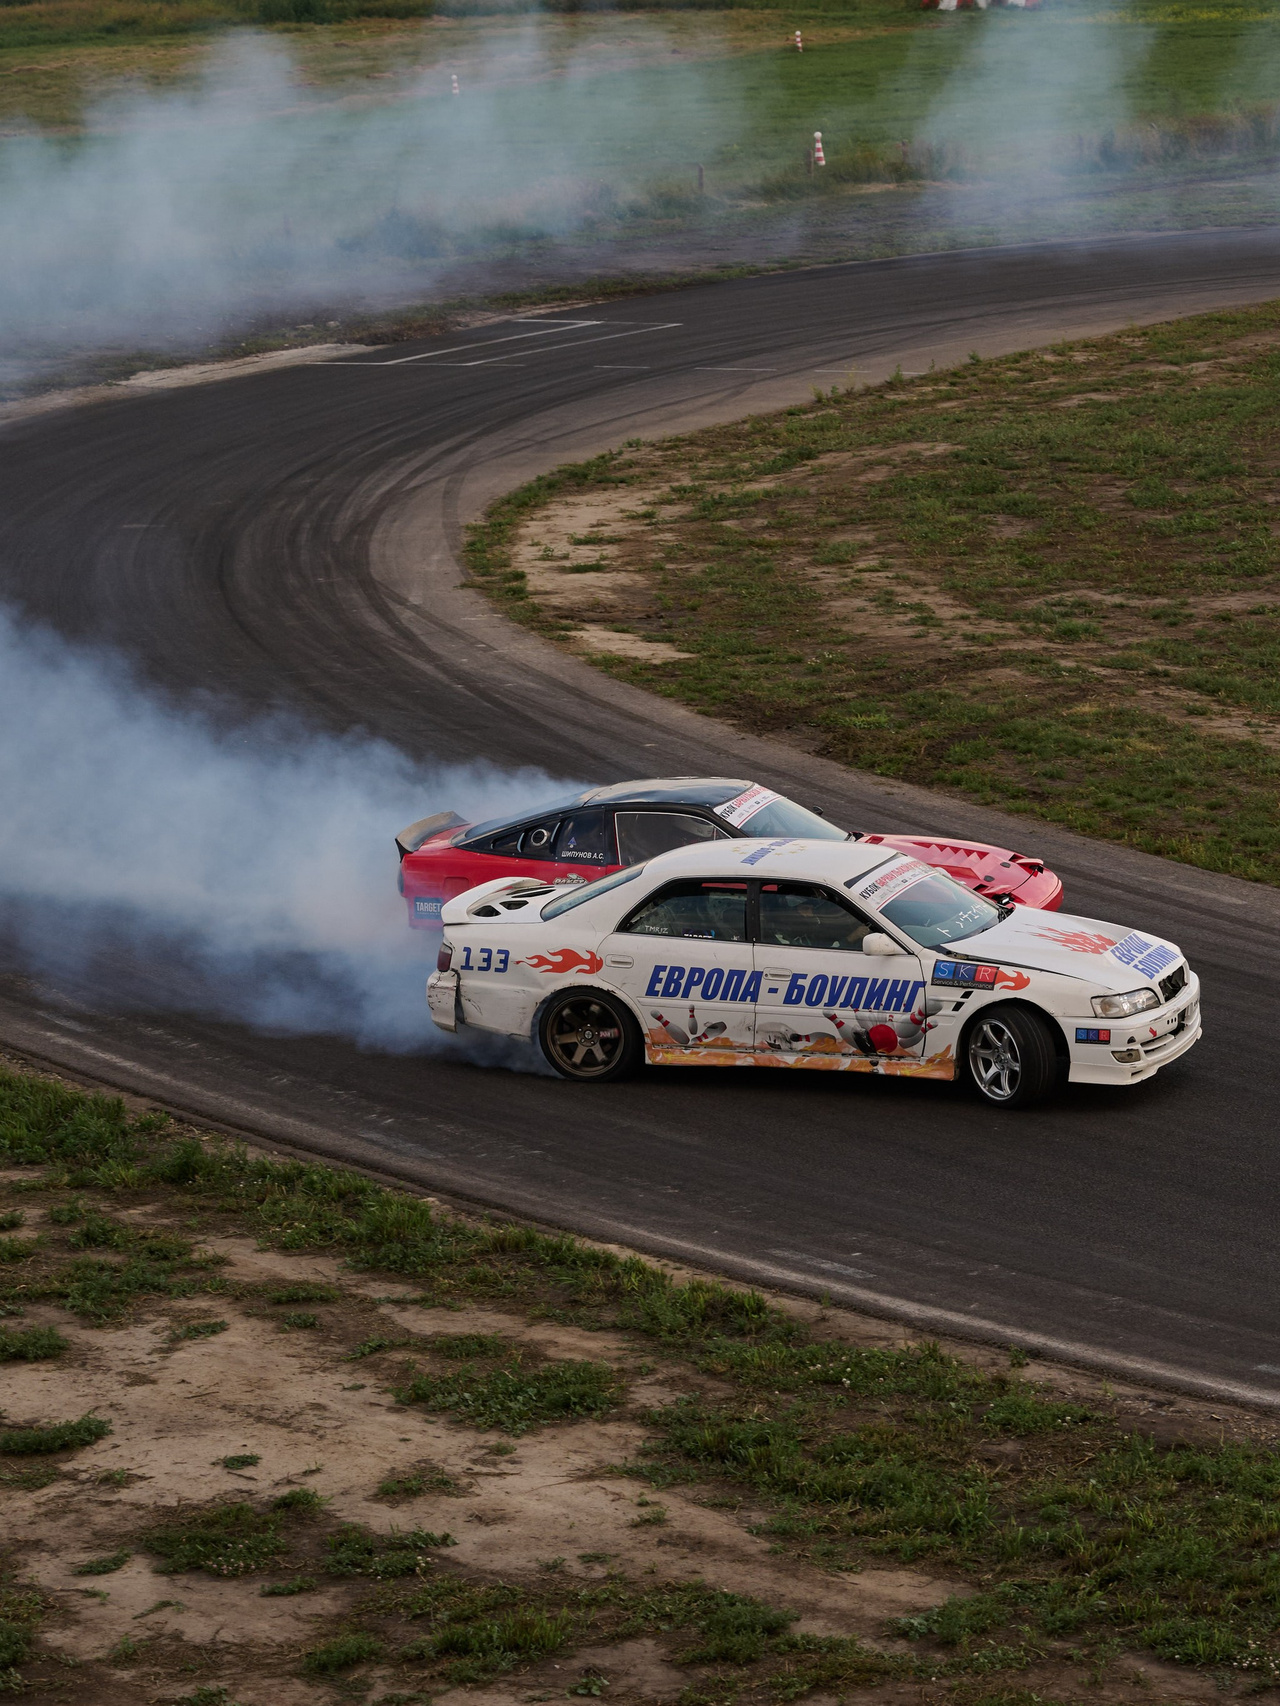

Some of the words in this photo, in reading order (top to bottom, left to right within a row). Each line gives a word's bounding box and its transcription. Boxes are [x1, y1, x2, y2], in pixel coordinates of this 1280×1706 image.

[561, 851, 592, 859] ШИПУНОВ
[859, 882, 881, 900] КУБОК
[415, 901, 442, 913] TARGET
[1109, 932, 1154, 966] ЕВРОПА
[460, 946, 510, 974] 133
[1132, 945, 1180, 980] БОУЛИНГ
[938, 962, 992, 980] SKR
[645, 965, 764, 1003] ЕВРОПА
[783, 973, 928, 1012] БОУЛИНГ
[1078, 1029, 1108, 1040] SKR
